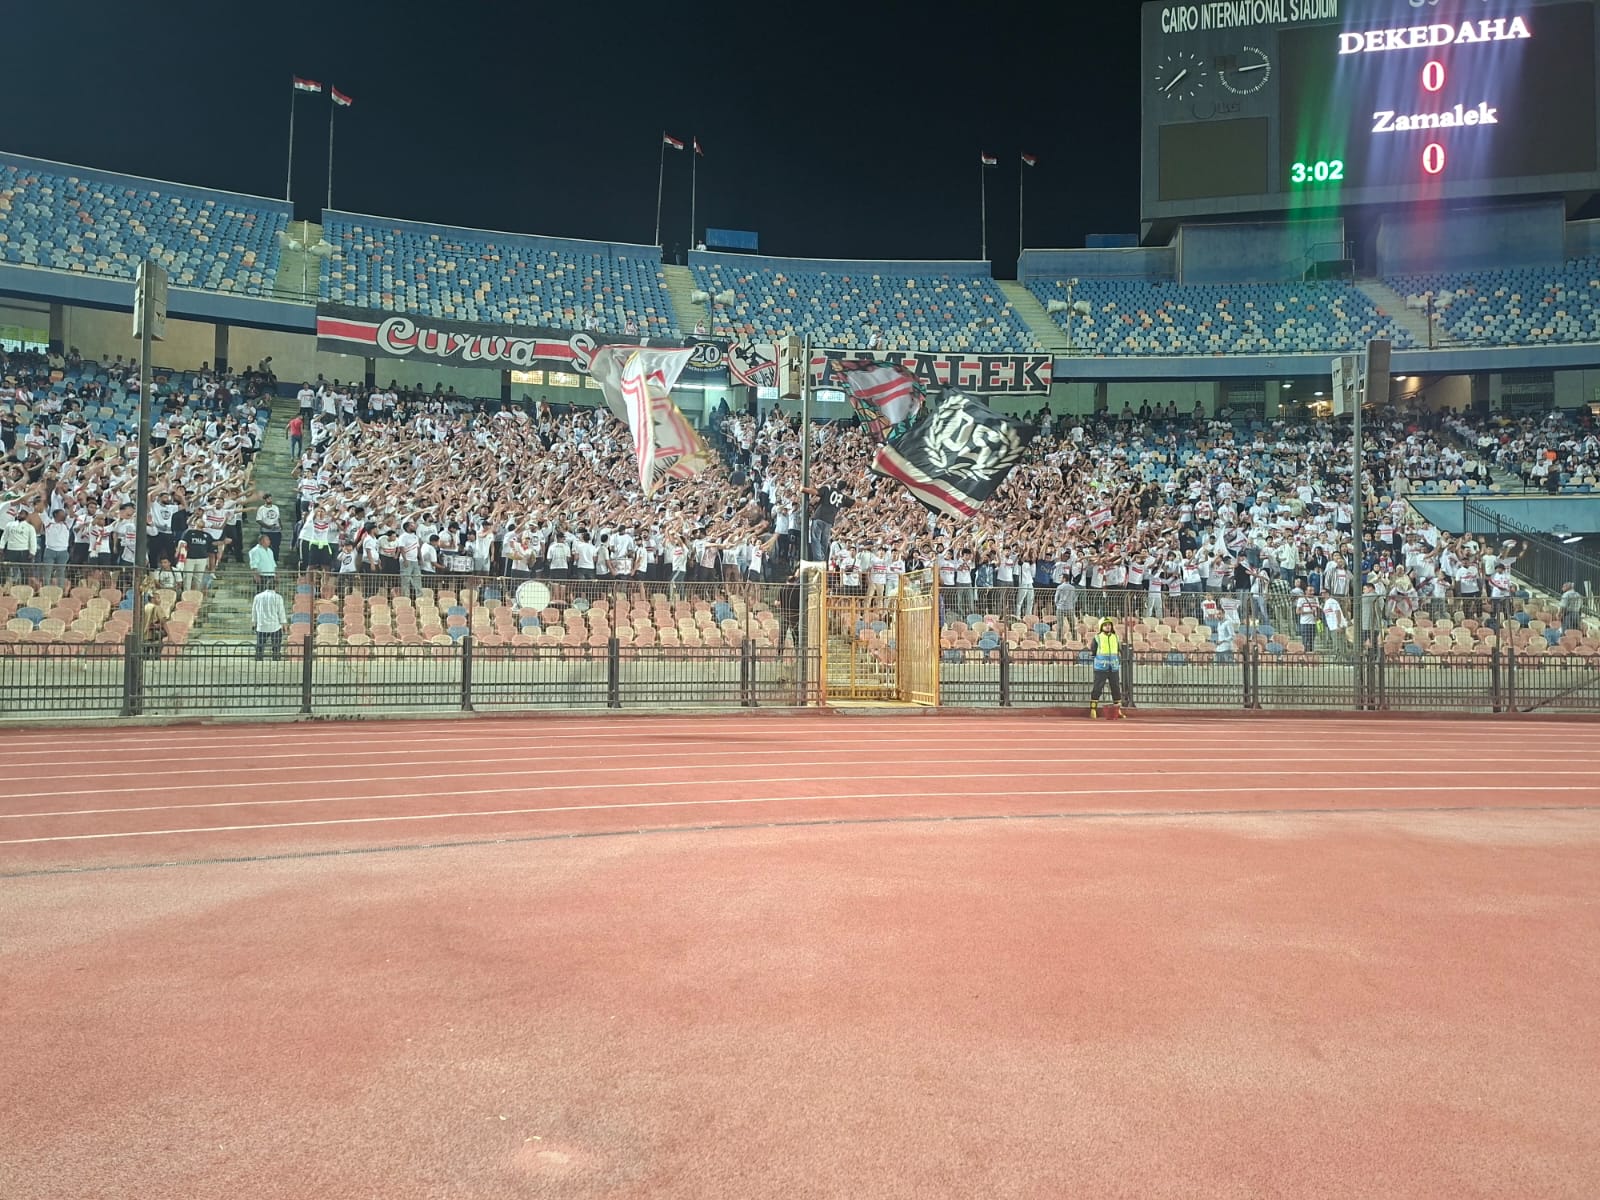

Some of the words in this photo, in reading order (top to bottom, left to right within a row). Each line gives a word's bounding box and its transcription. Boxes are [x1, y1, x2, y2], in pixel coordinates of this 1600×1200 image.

[1162, 6, 1198, 33] CAIRO
[1201, 0, 1287, 30] INTERNATIONAL
[1290, 0, 1337, 21] STADIUM
[1338, 16, 1531, 55] DEKEDAHA
[1422, 61, 1445, 92] 0
[1372, 102, 1498, 133] Zamalek
[1291, 160, 1344, 183] 3:02
[1422, 143, 1445, 174] 0
[376, 317, 539, 367] Curva
[688, 343, 720, 364] 20
